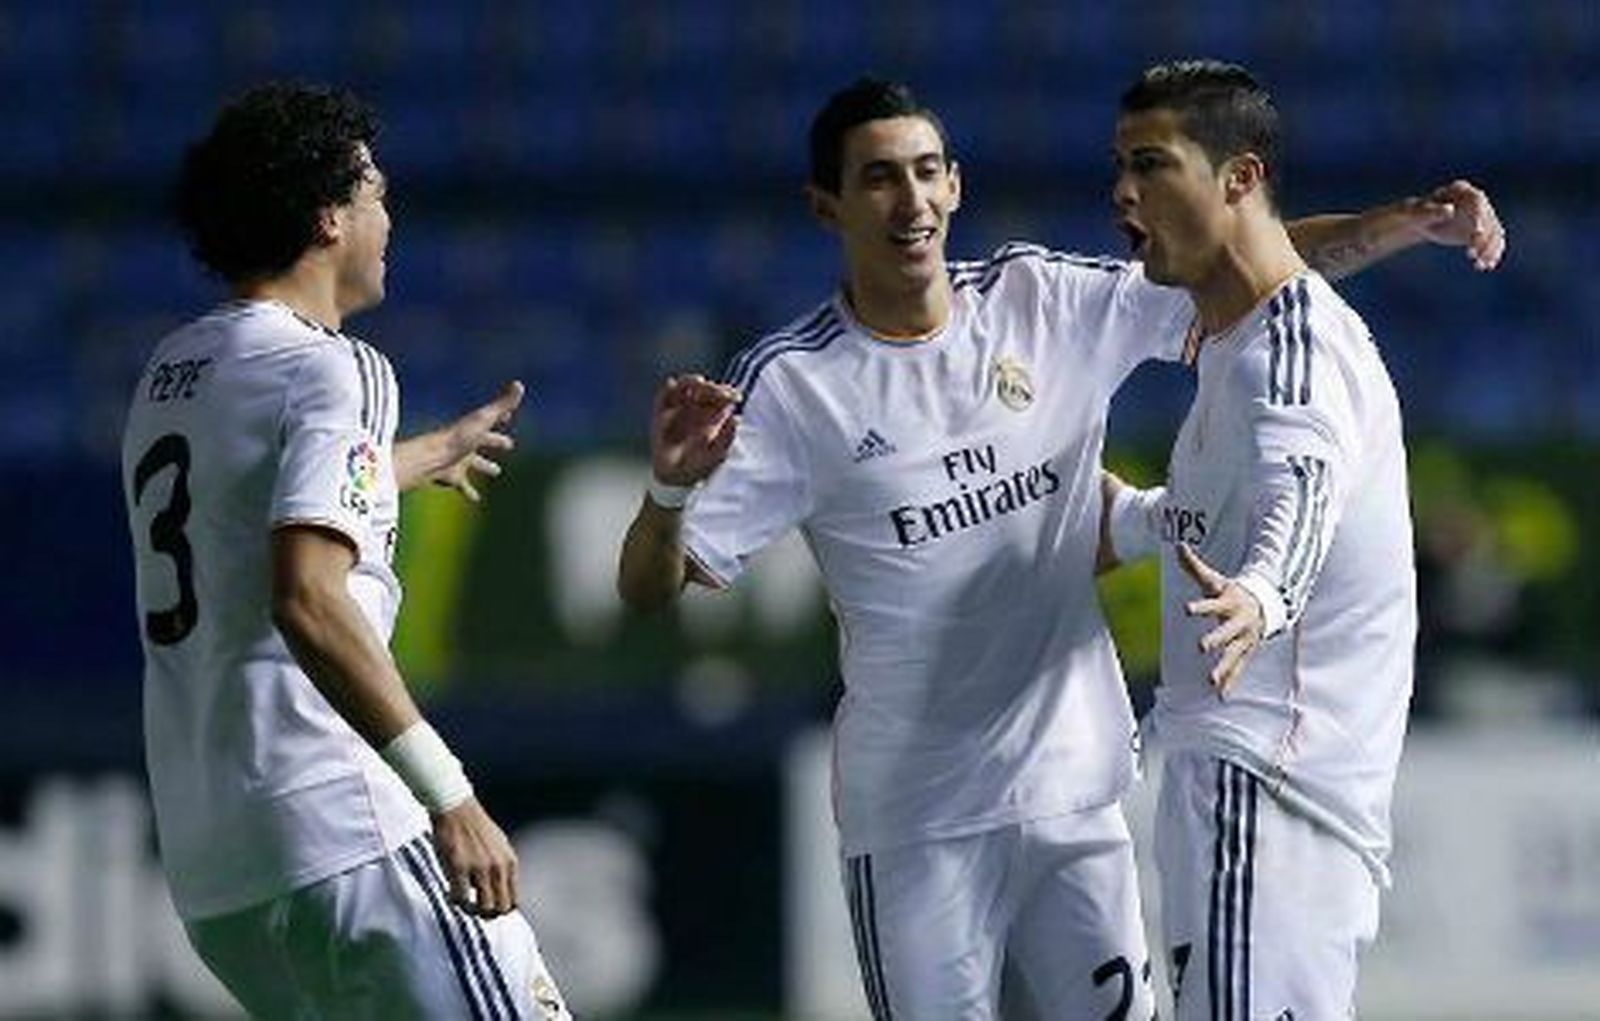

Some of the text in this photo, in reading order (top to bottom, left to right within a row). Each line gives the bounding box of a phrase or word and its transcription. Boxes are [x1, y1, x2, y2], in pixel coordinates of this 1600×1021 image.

[149, 357, 213, 402] PEPE
[942, 444, 996, 482] Fly
[889, 458, 1061, 547] Emirates
[134, 434, 198, 646] 3
